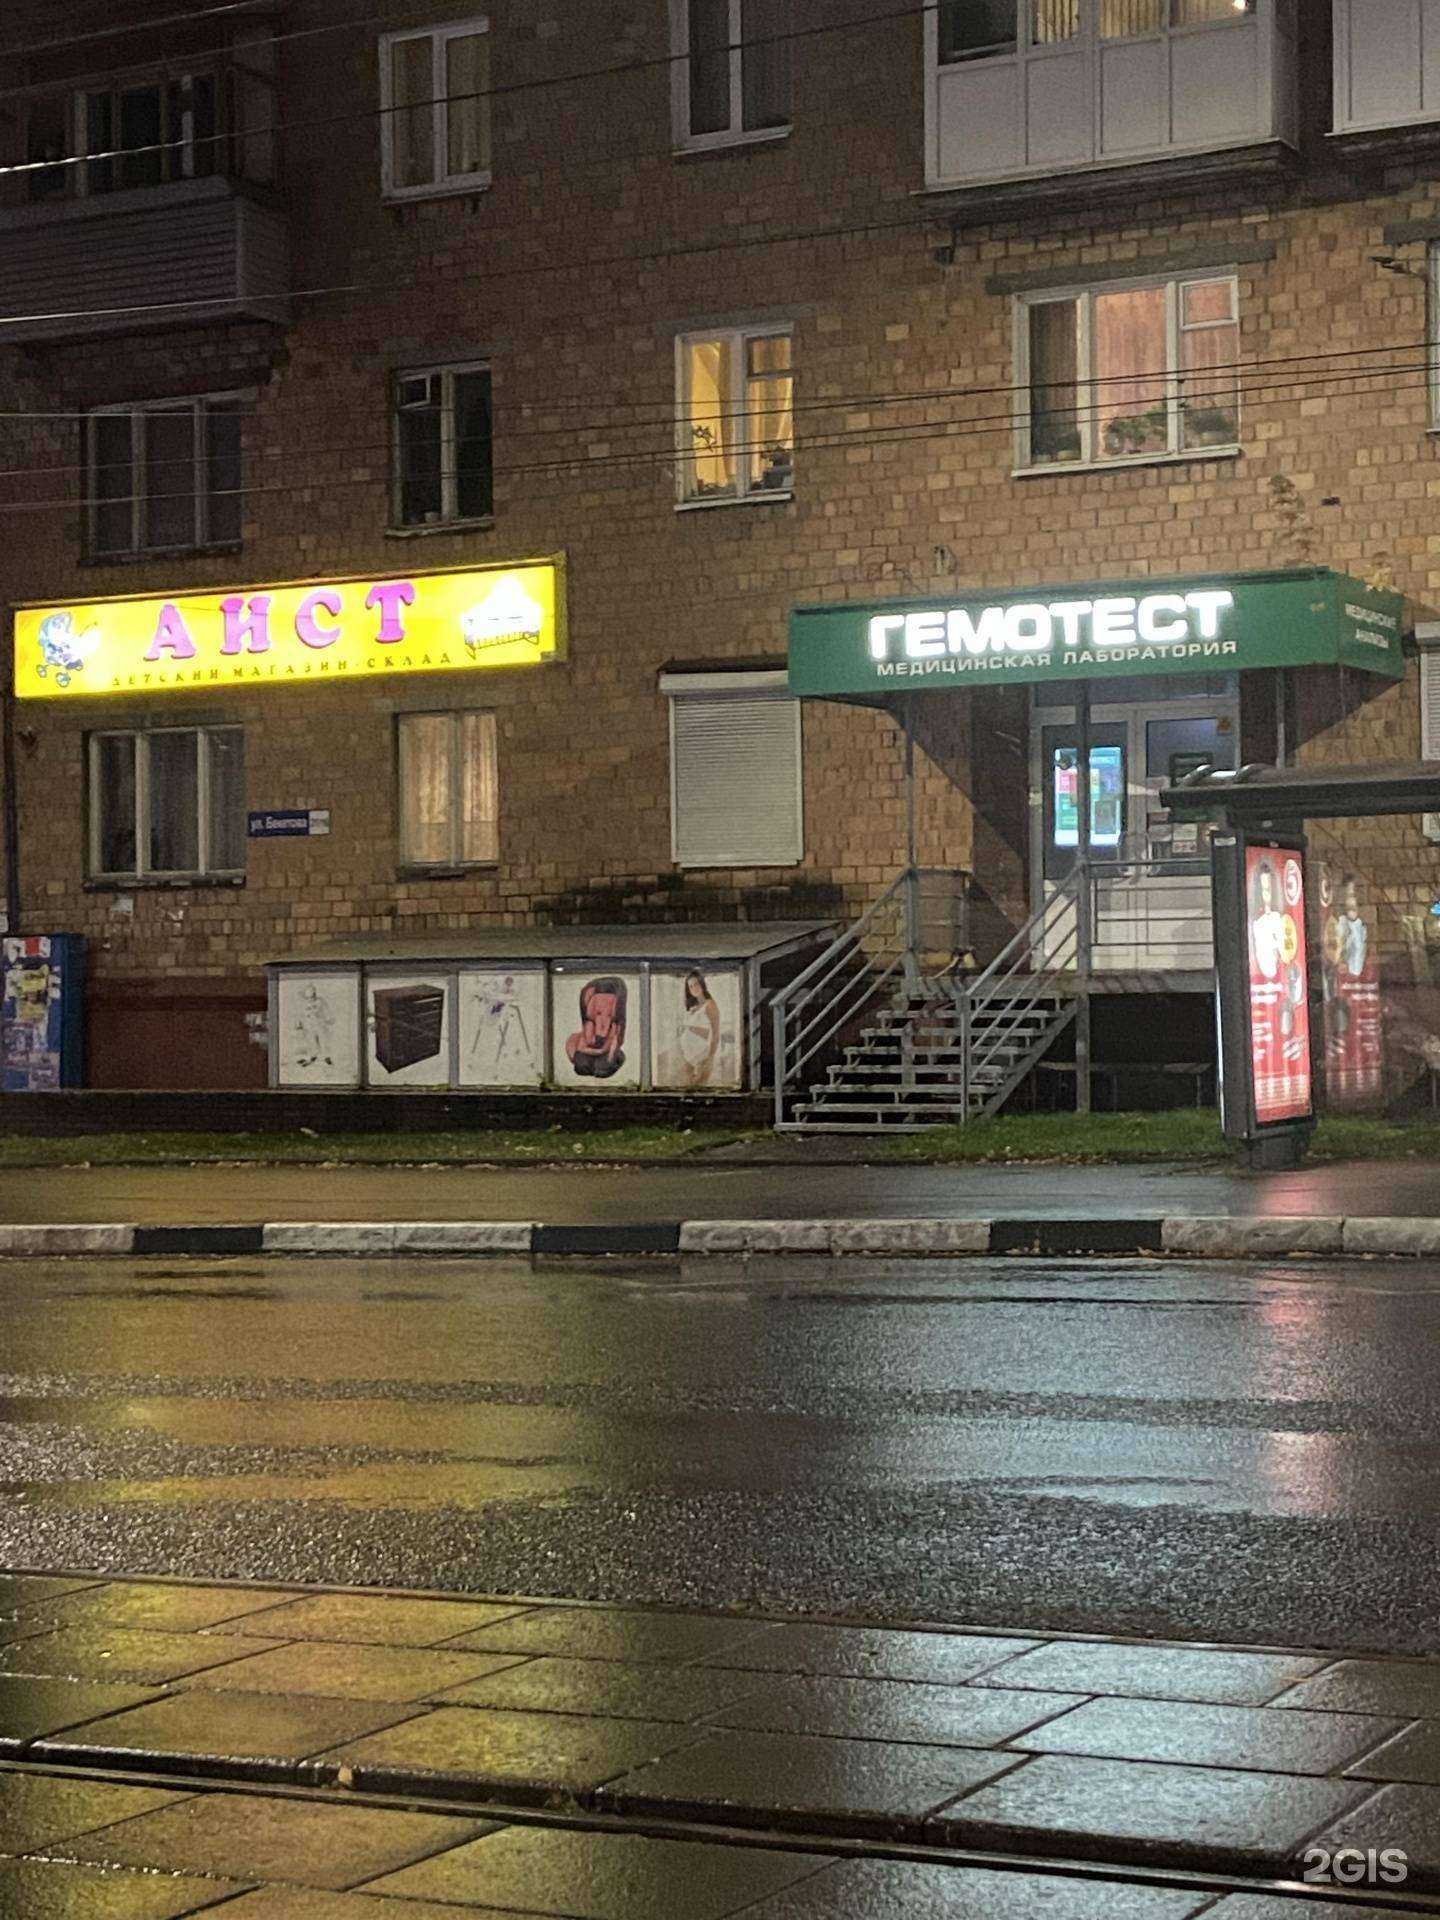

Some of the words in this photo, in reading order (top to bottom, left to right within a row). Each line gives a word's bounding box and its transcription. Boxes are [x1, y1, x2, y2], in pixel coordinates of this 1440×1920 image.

[143, 582, 416, 661] АИСТ
[868, 590, 1234, 659] ГЕМОТЕСТ
[876, 652, 1052, 677] МЕДИЦИНСКАЯ
[1063, 640, 1238, 665] ЛАБОРАТОРИЯ
